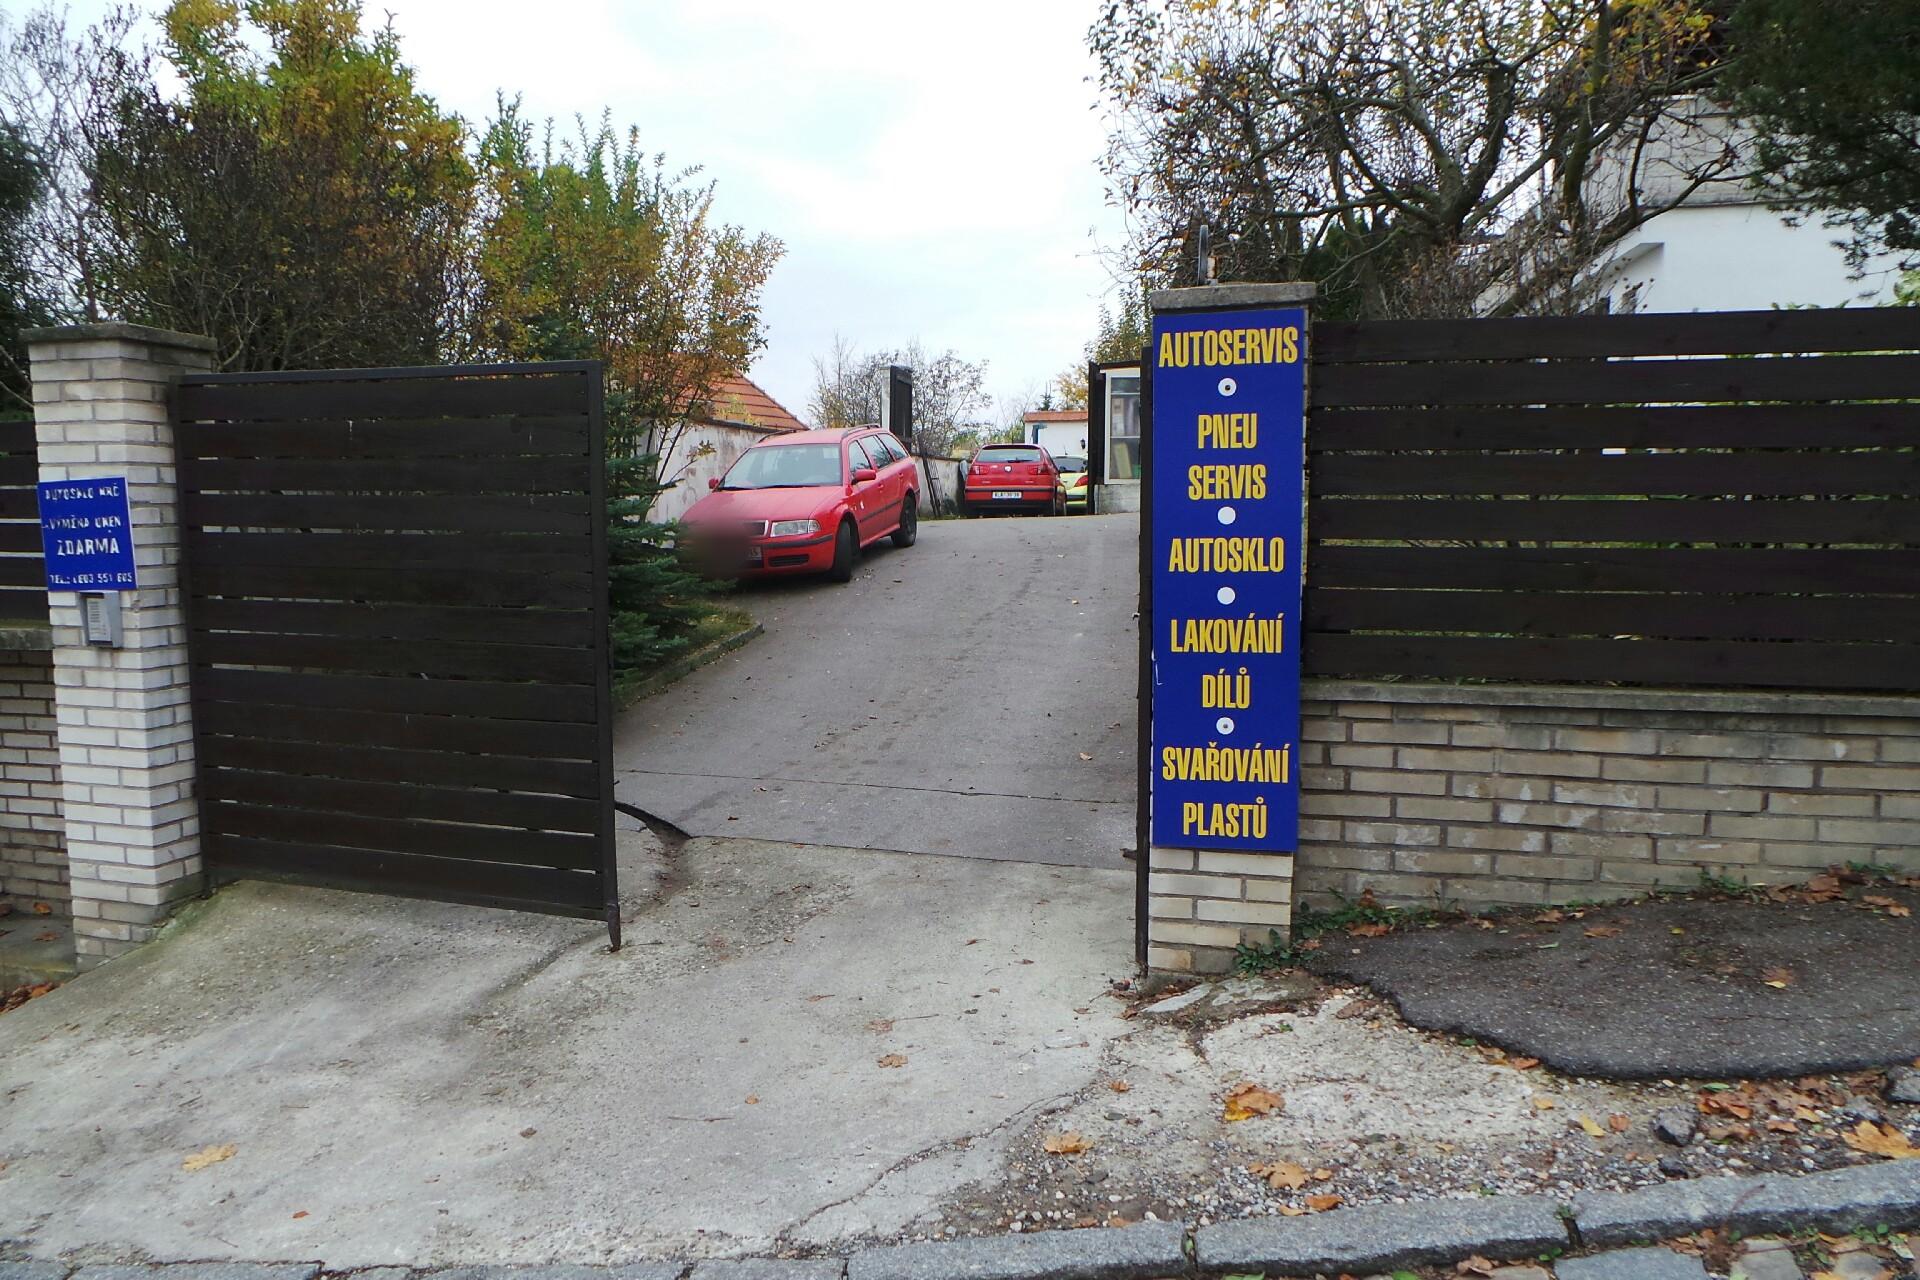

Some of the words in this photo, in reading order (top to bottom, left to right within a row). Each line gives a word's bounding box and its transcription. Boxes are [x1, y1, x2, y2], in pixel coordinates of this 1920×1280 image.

[1158, 326, 1298, 368] AUTOSERVIS
[1197, 413, 1258, 449] PNEU
[1188, 463, 1267, 500] SERVIS
[56, 537, 121, 556] ZDARMA
[1168, 537, 1285, 573] AUTOSKLO
[1170, 612, 1285, 654] LAKOVÁNÍ
[1202, 667, 1251, 709] DÍLŮ
[1162, 741, 1291, 784] SVAŘOVÁNÍ
[1183, 796, 1268, 839] PLASTŮ
